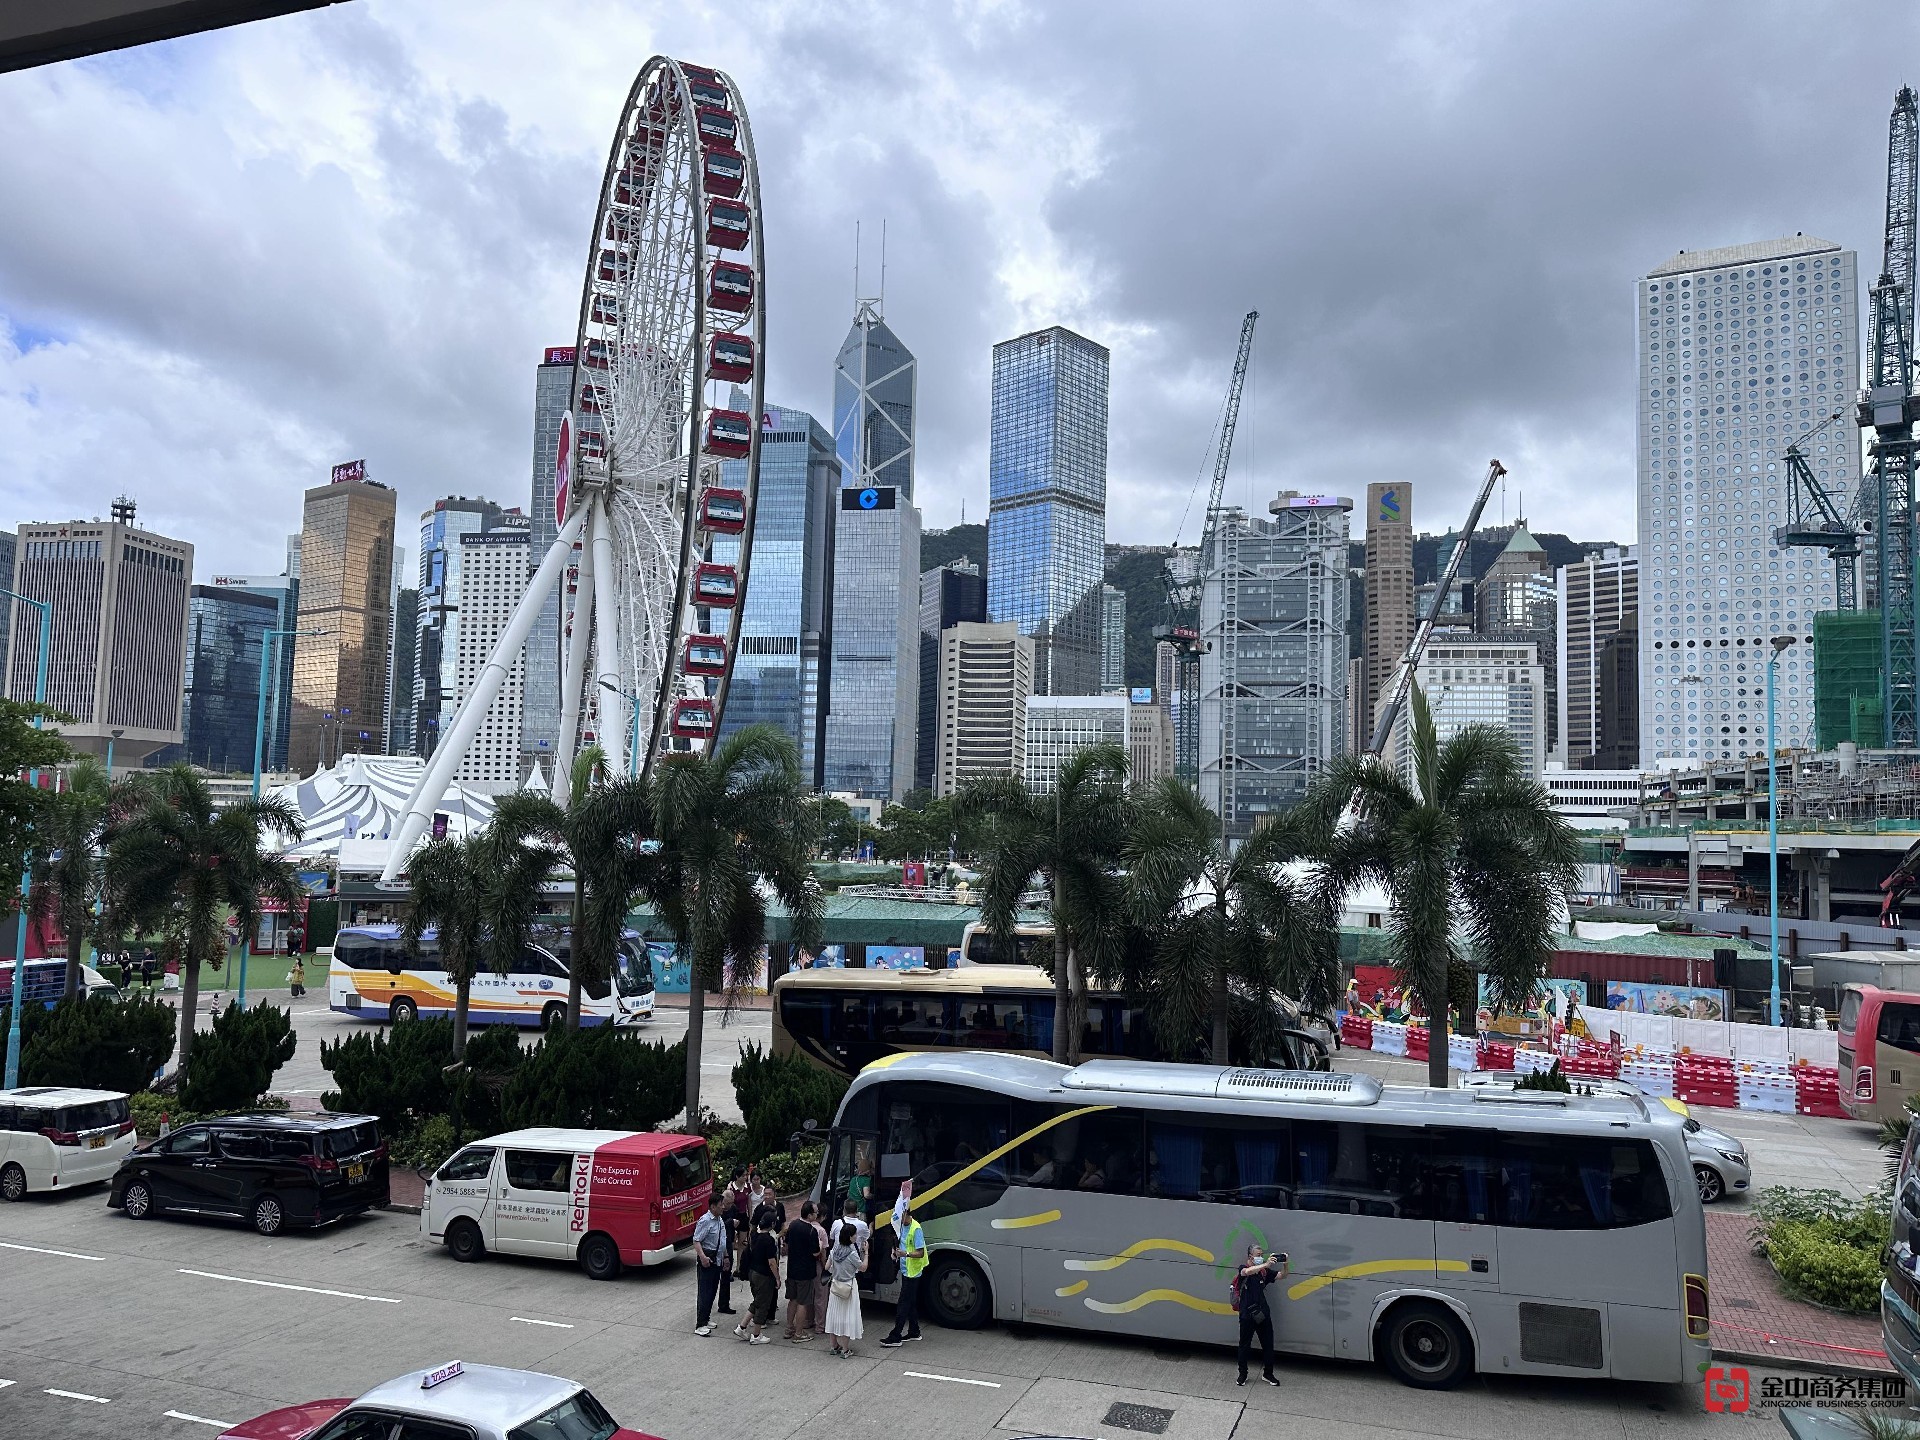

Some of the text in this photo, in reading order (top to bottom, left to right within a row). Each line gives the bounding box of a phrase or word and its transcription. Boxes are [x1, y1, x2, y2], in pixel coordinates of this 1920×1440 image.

[504, 517, 531, 526] LIPP
[1445, 634, 1528, 642] MANDARIN ORIENTAL
[595, 1165, 640, 1176] The Experts in
[593, 1176, 633, 1186] Pest Control
[570, 1154, 591, 1232] Rentokil
[662, 1192, 688, 1209] Rentokil
[431, 1361, 461, 1382] TAXI
